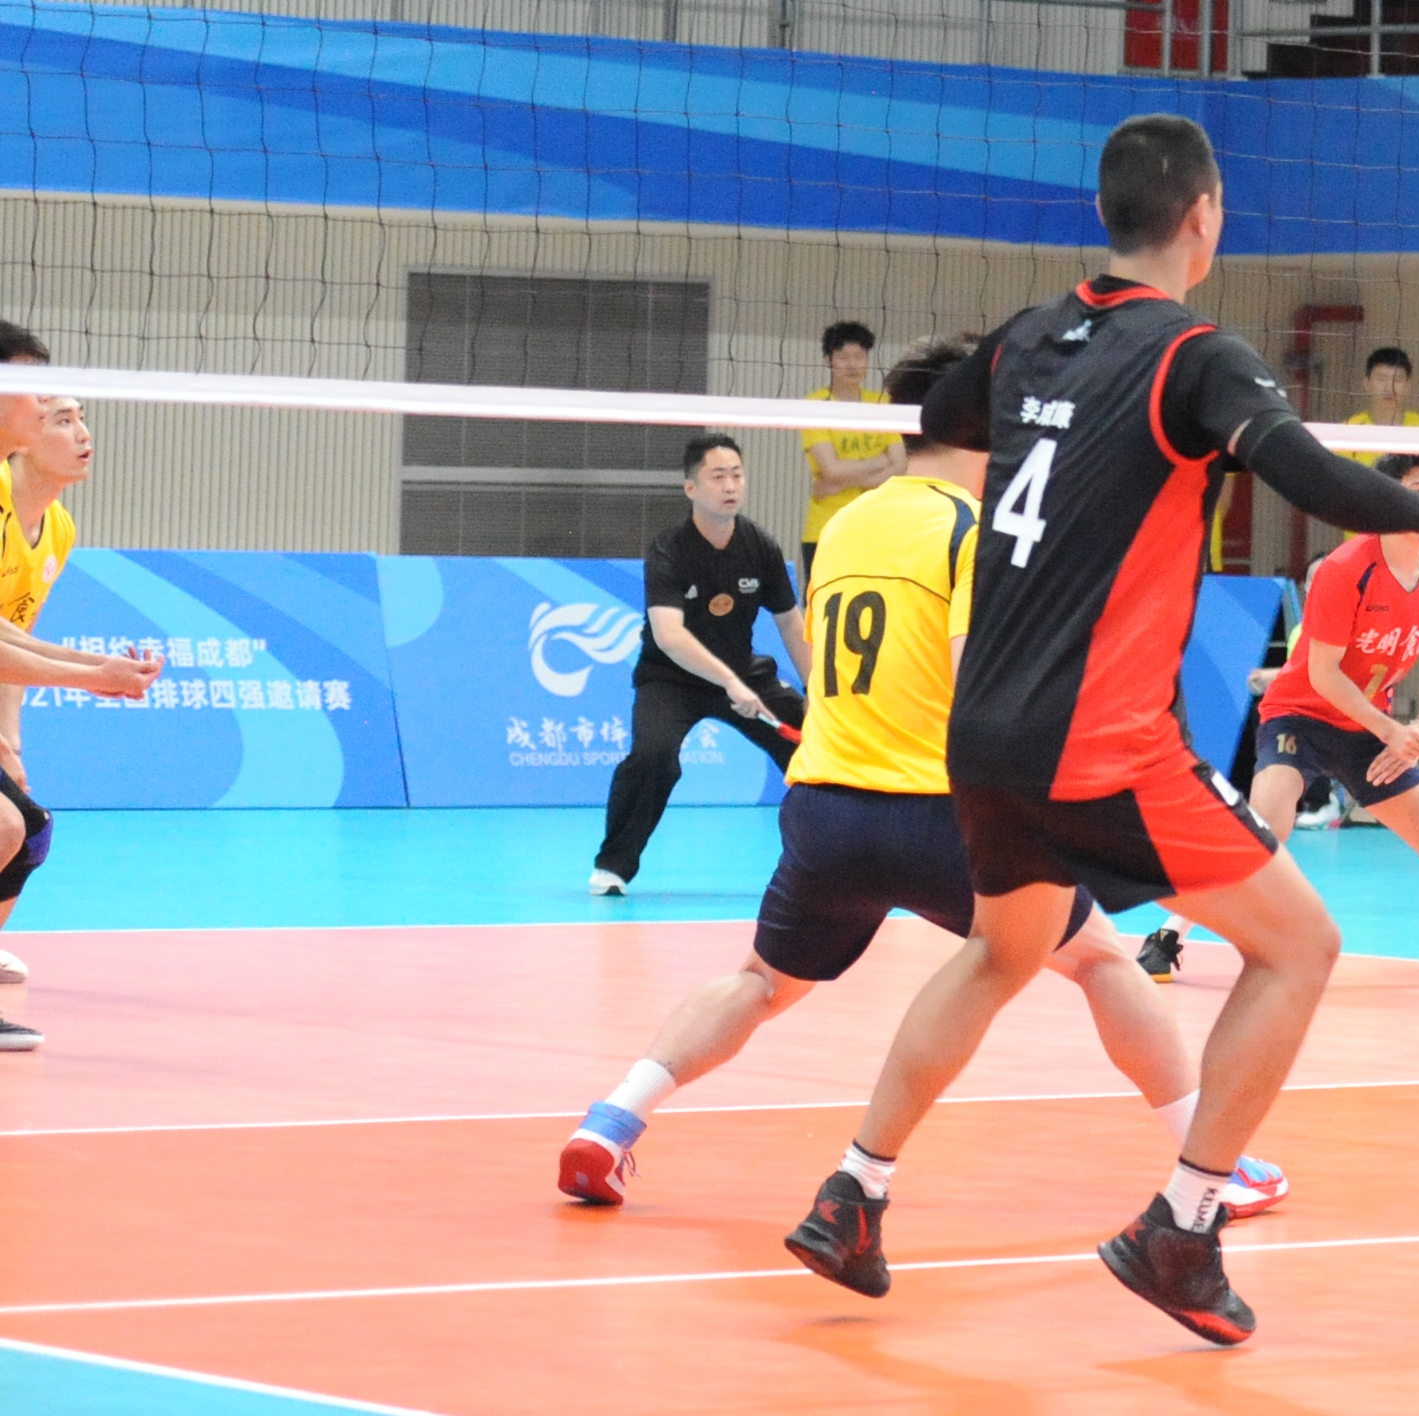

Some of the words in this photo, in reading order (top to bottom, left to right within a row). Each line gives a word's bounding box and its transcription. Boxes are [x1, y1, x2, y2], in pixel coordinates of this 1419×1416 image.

[992, 437, 1058, 569] 4
[823, 590, 887, 699] 19
[509, 751, 580, 768] CHENGDU
[583, 751, 630, 768] SPORT
[1276, 733, 1298, 756] 16
